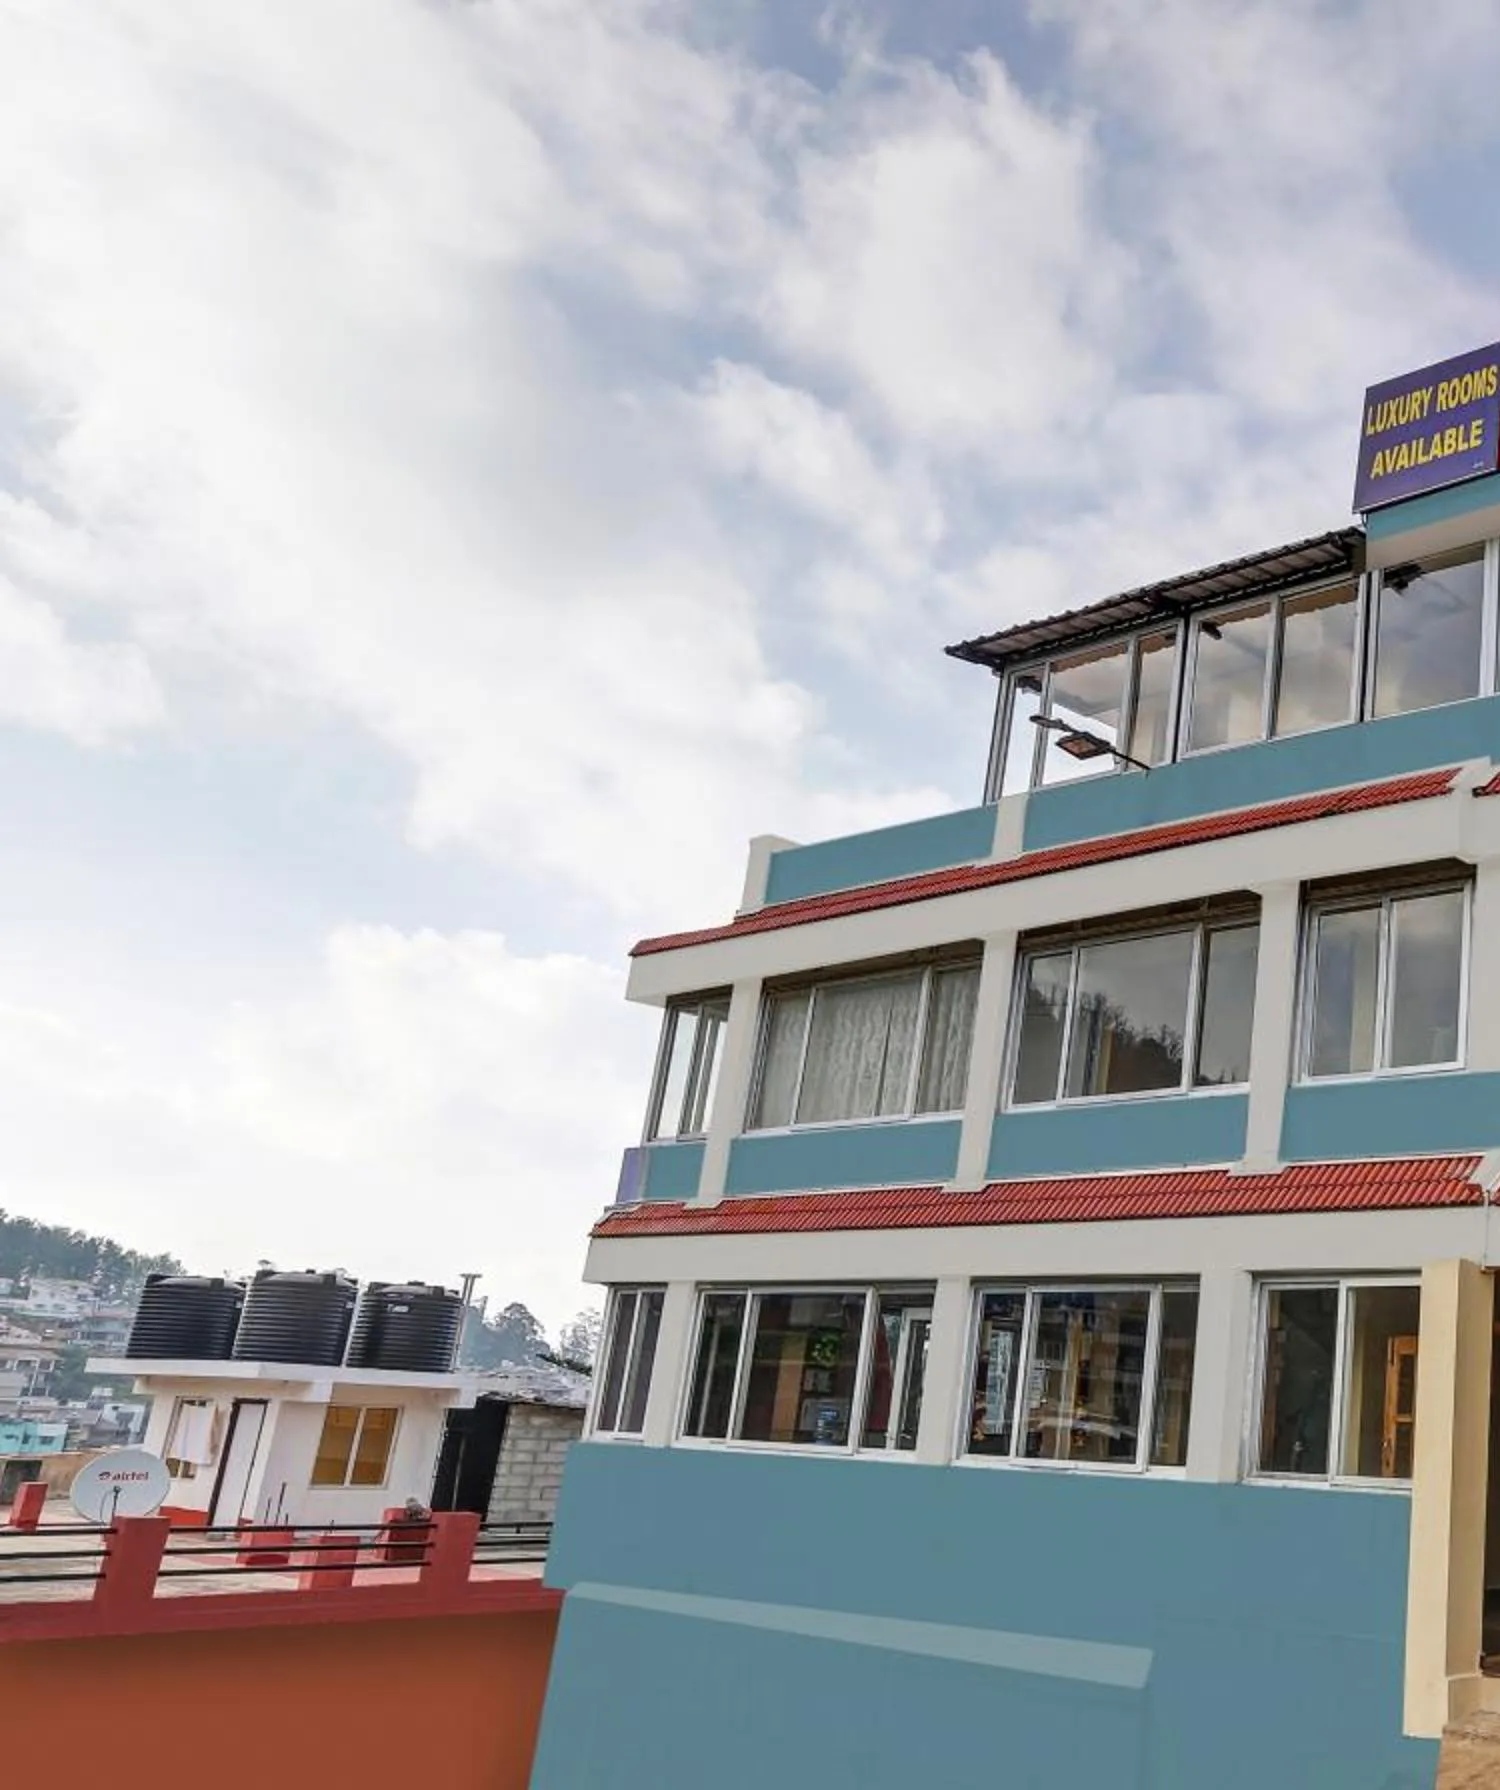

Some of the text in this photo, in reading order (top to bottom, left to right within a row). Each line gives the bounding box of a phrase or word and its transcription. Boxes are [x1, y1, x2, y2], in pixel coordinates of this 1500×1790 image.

[1366, 364, 1498, 436] LUXURY ROOMS
[1370, 418, 1485, 479] AVAILABLE
[111, 1471, 149, 1481] airtel
